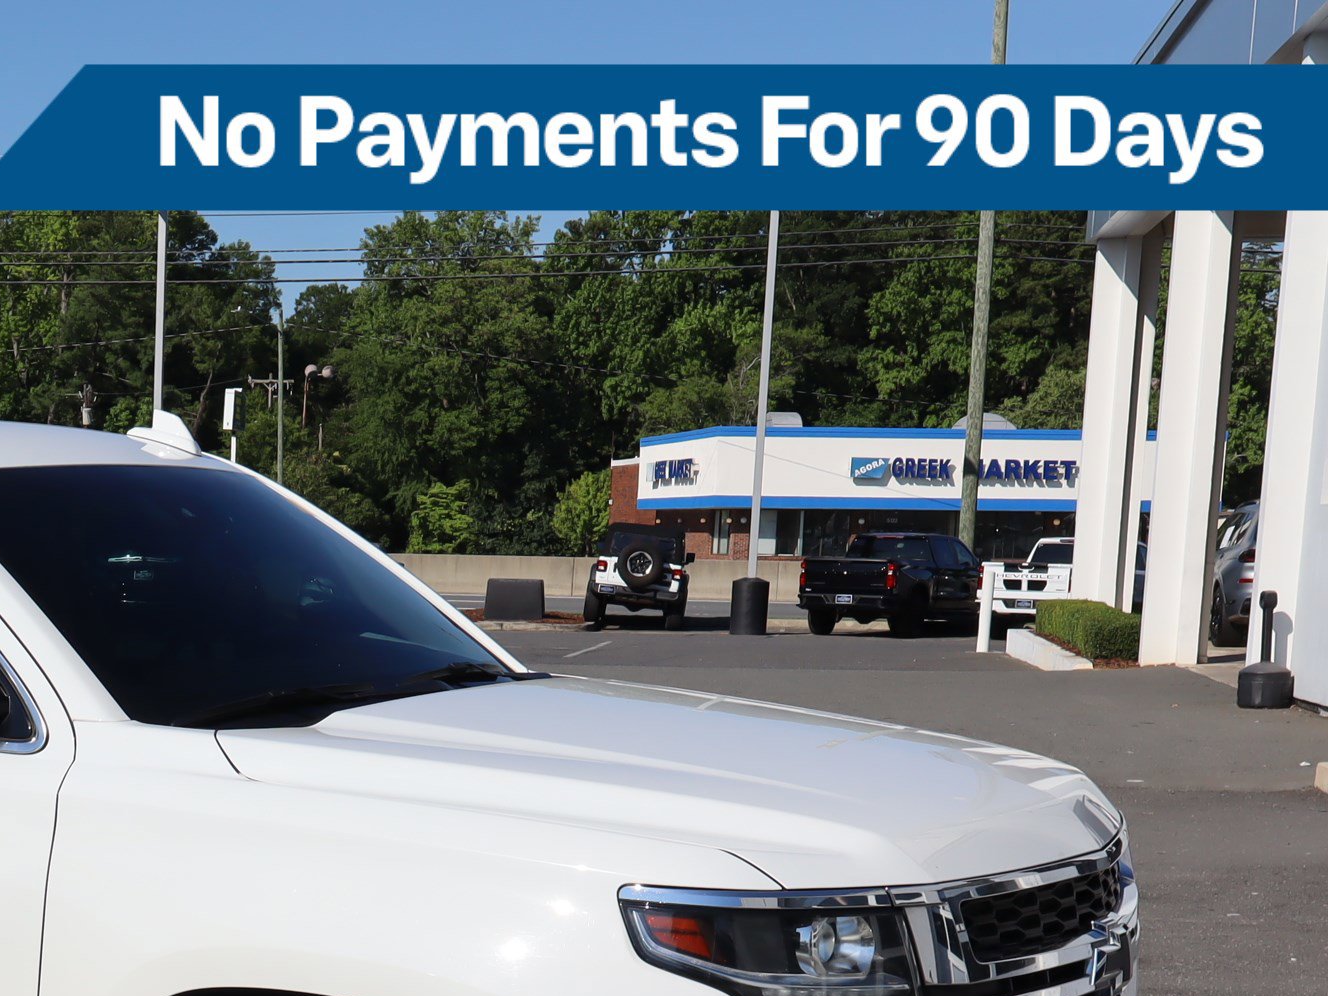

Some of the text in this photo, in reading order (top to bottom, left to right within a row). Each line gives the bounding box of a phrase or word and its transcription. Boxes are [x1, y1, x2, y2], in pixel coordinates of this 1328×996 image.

[854, 457, 1077, 481] AGORA GREEK ARKET
